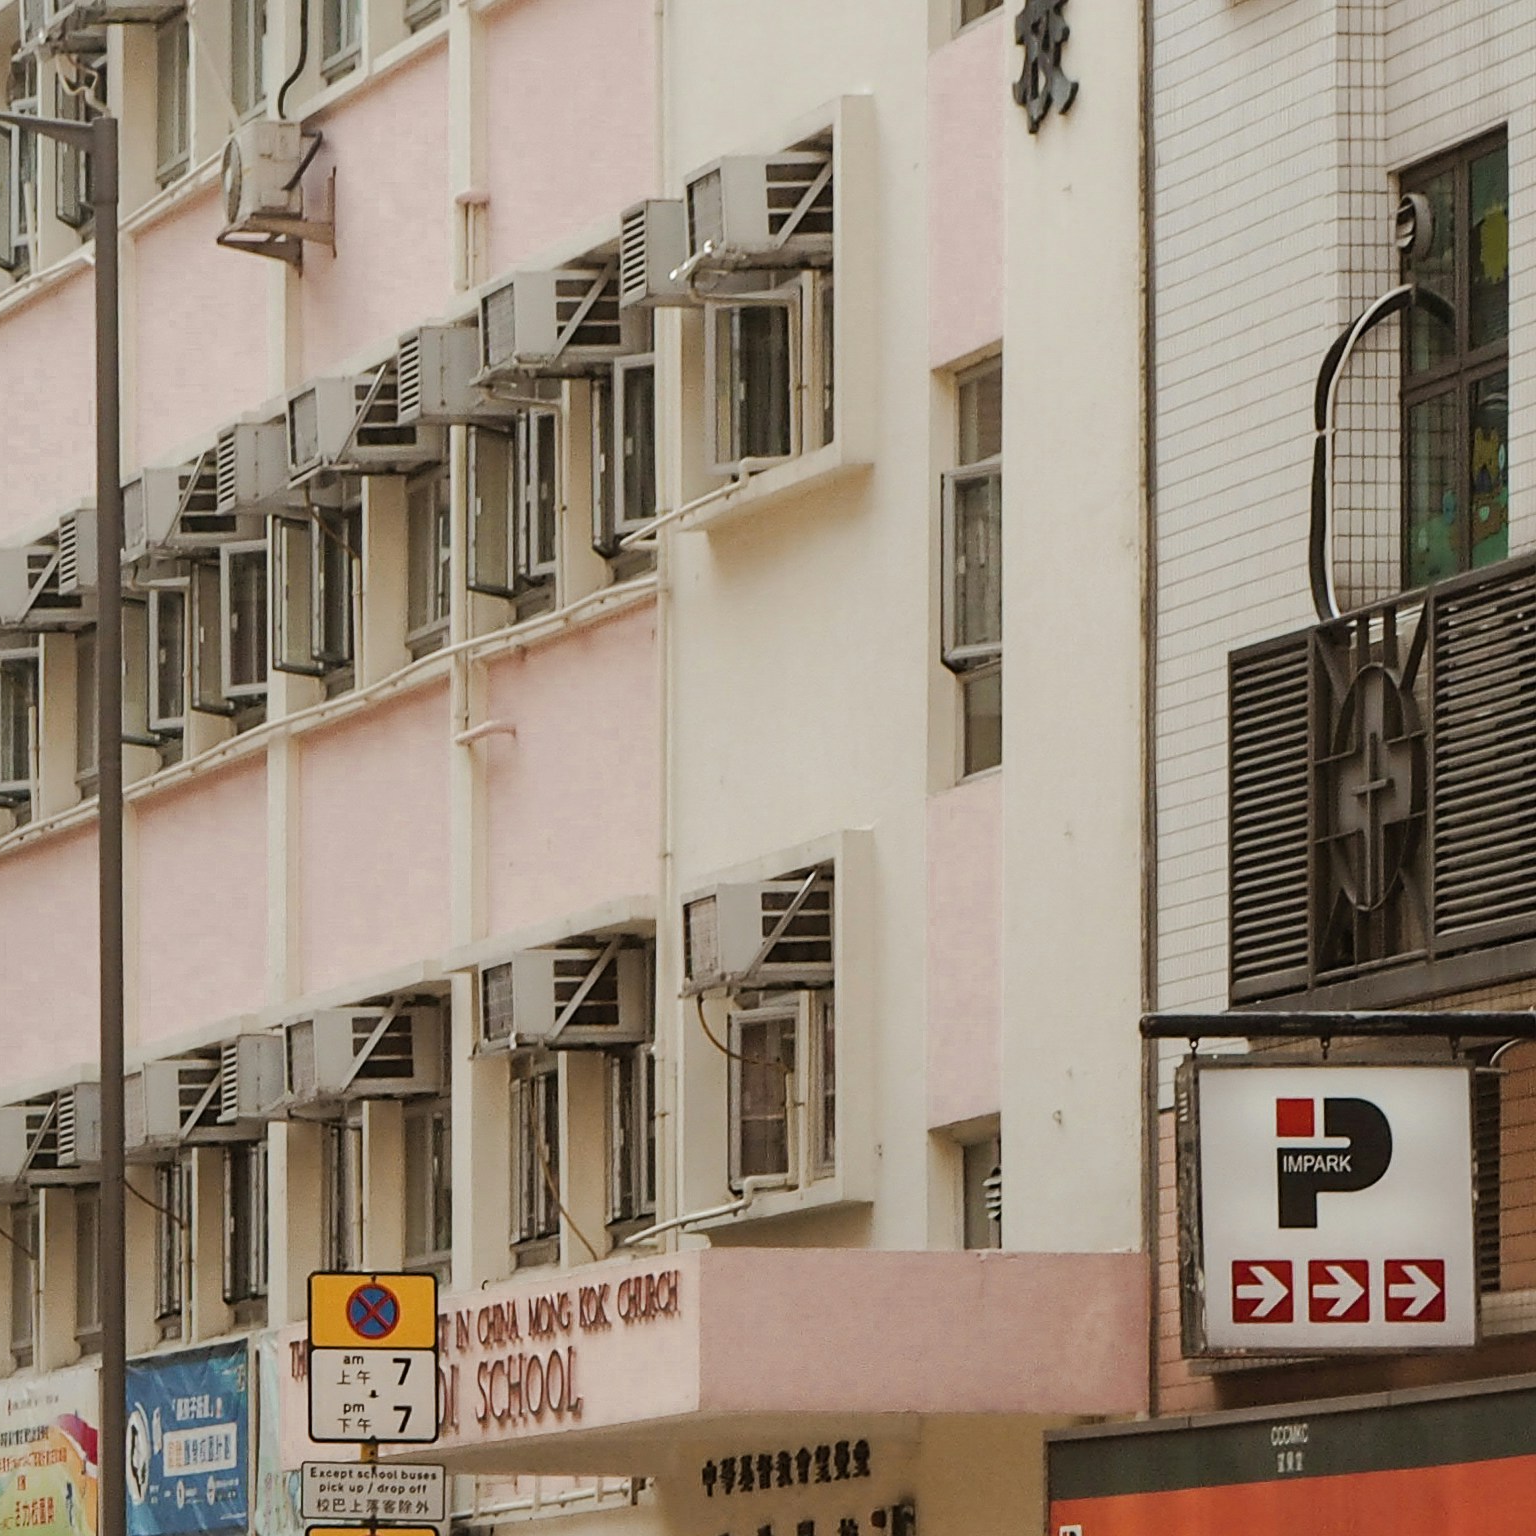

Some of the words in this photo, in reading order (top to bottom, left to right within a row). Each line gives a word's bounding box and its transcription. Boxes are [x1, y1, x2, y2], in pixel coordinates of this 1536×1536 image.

[1281, 1154, 1352, 1174] IMPARK
[477, 1298, 522, 1347] CHINA
[528, 1291, 571, 1338] MONG
[578, 1282, 611, 1329] KOK
[617, 1269, 681, 1324] CHURCH
[336, 1369, 371, 1386] 上午
[343, 1354, 364, 1365] am
[392, 1357, 412, 1386] 7
[475, 1345, 583, 1426] SCHOOL
[337, 1417, 371, 1433] 下午
[343, 1401, 365, 1414] pm
[392, 1405, 413, 1434] 7
[310, 1467, 354, 1480] Except
[356, 1468, 398, 1481] school
[400, 1470, 437, 1482] buses
[319, 1482, 344, 1495] pick
[347, 1484, 365, 1496] up
[376, 1483, 405, 1497] drop
[407, 1484, 428, 1495] off
